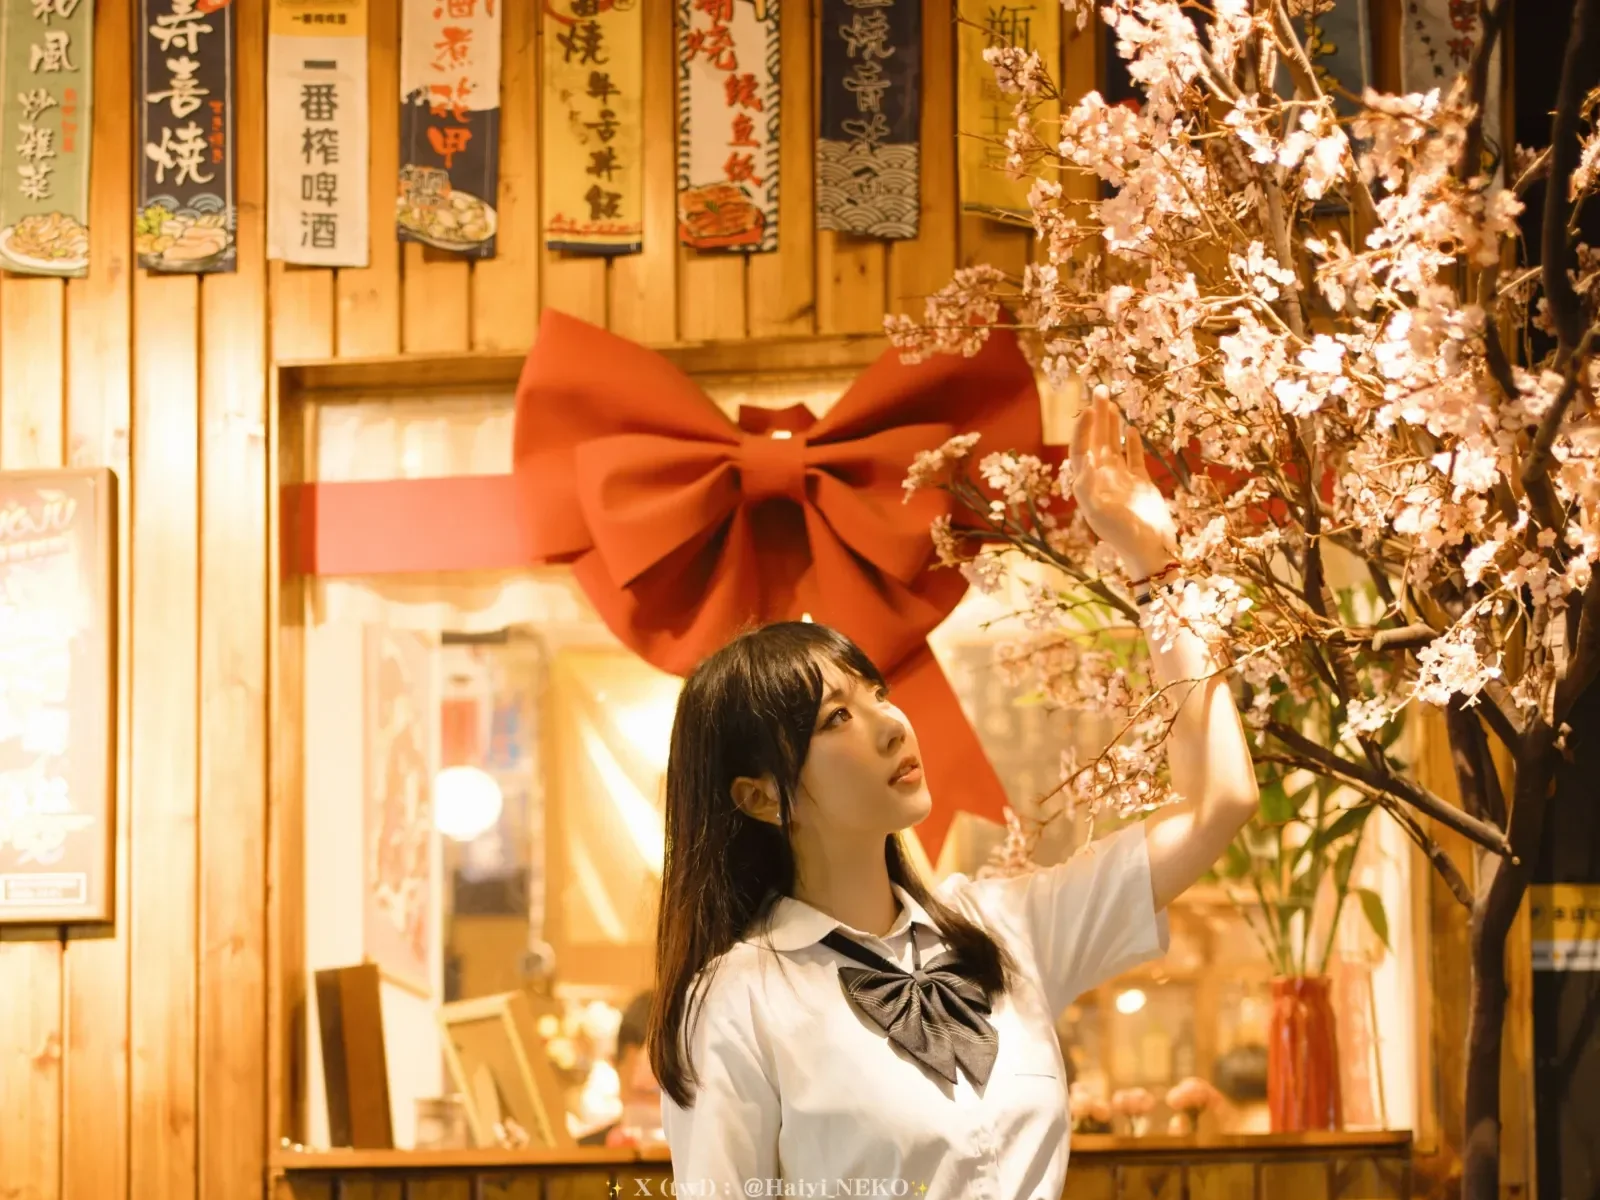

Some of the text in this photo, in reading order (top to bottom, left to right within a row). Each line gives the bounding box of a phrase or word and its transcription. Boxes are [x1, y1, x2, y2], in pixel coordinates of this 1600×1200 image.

[300, 59, 339, 250] 一番榨啤酒
